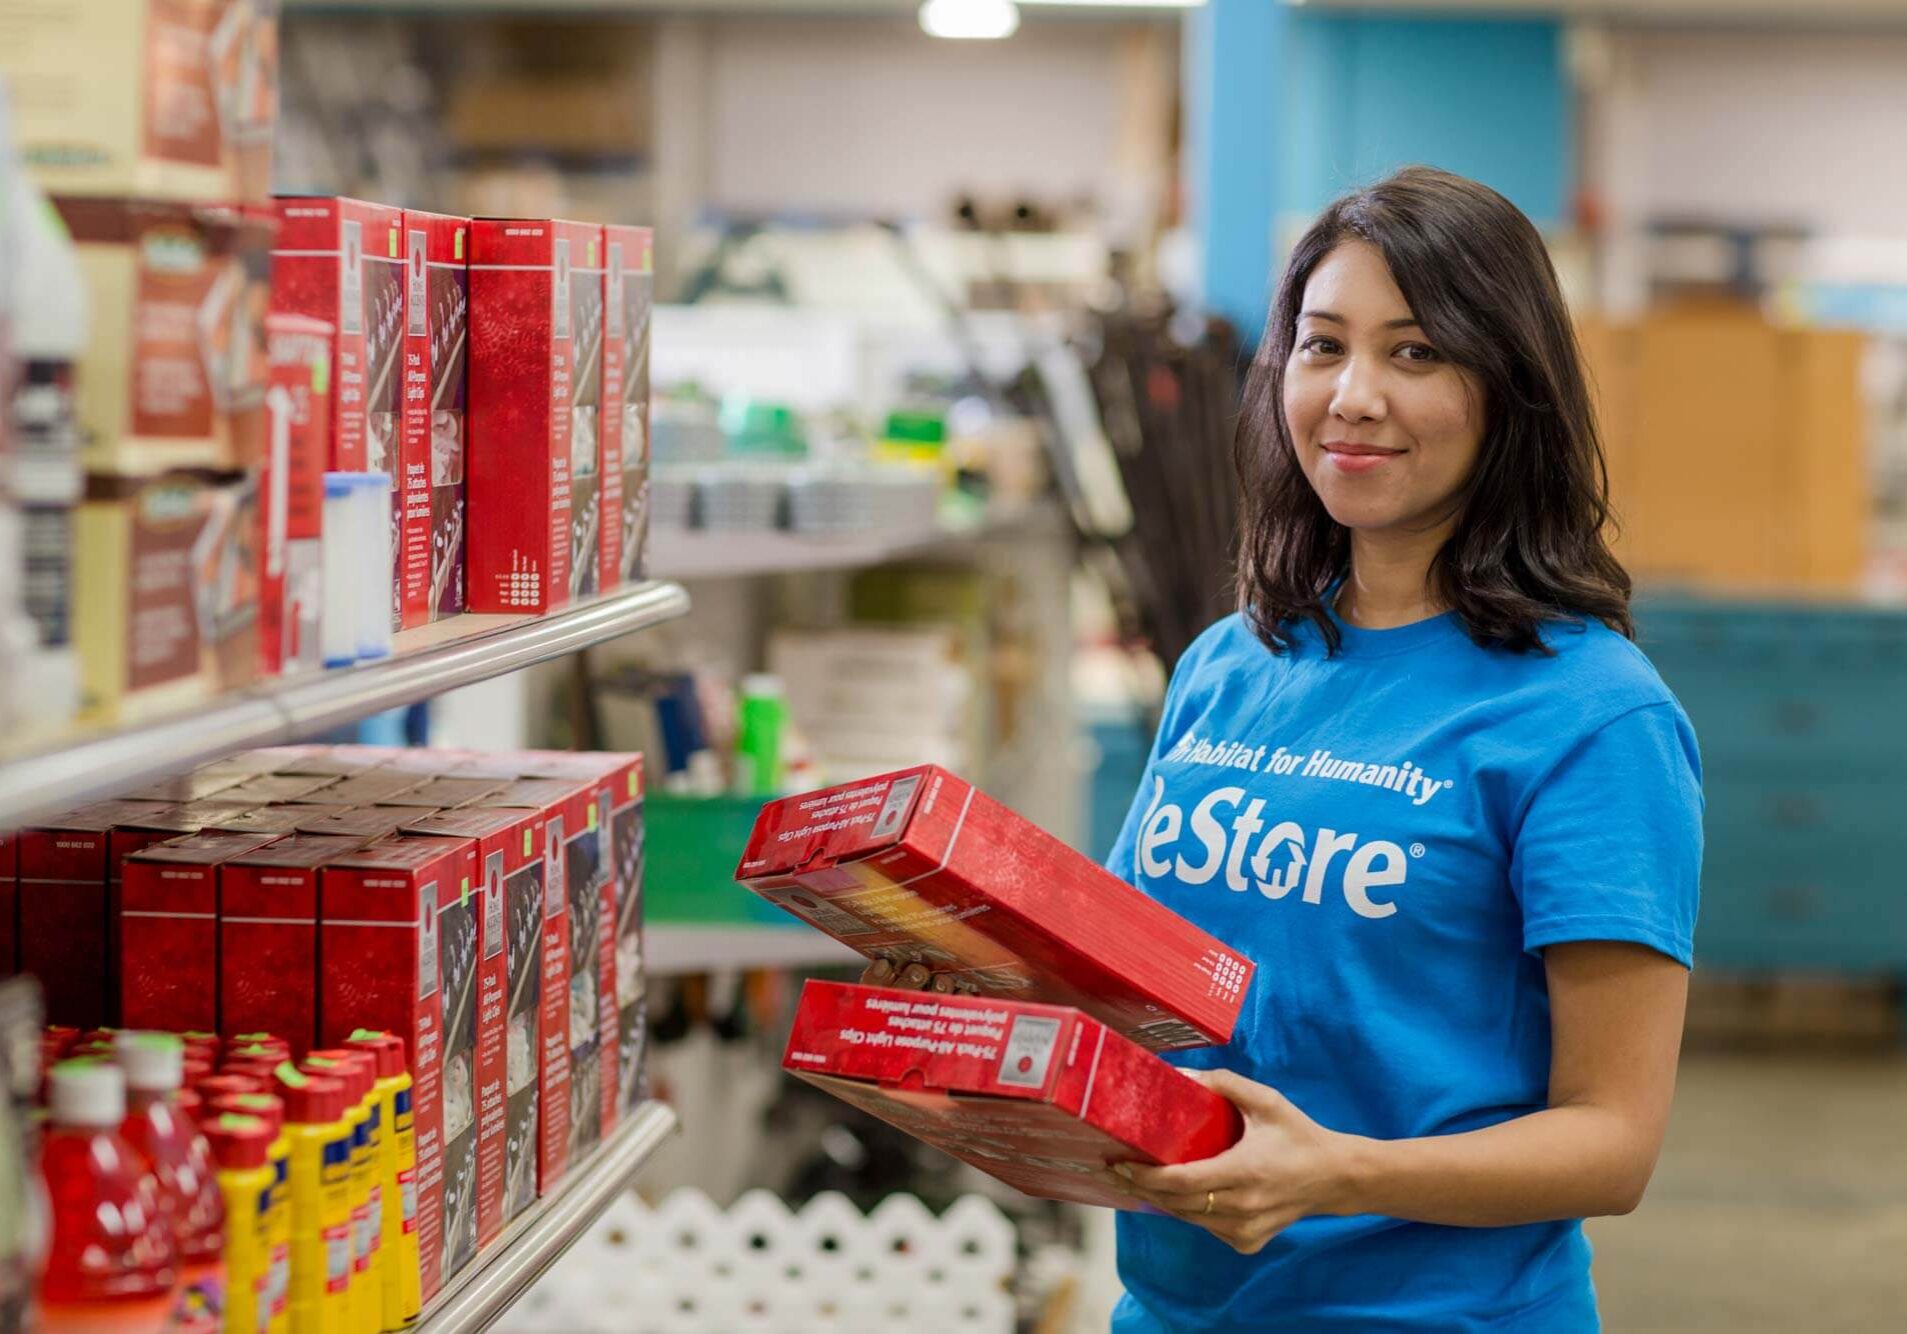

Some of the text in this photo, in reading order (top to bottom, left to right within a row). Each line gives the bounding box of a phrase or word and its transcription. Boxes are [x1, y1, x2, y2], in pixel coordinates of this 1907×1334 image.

[1187, 738, 1266, 774] Habitat
[1266, 746, 1304, 776] for
[838, 803, 849, 815] 75
[848, 801, 859, 812] de
[777, 830, 794, 843] Clips
[793, 825, 812, 839] Light
[932, 1019, 948, 1035] 75
[949, 1021, 964, 1037] de
[839, 1028, 866, 1045] Clips
[865, 1031, 894, 1048] Light
